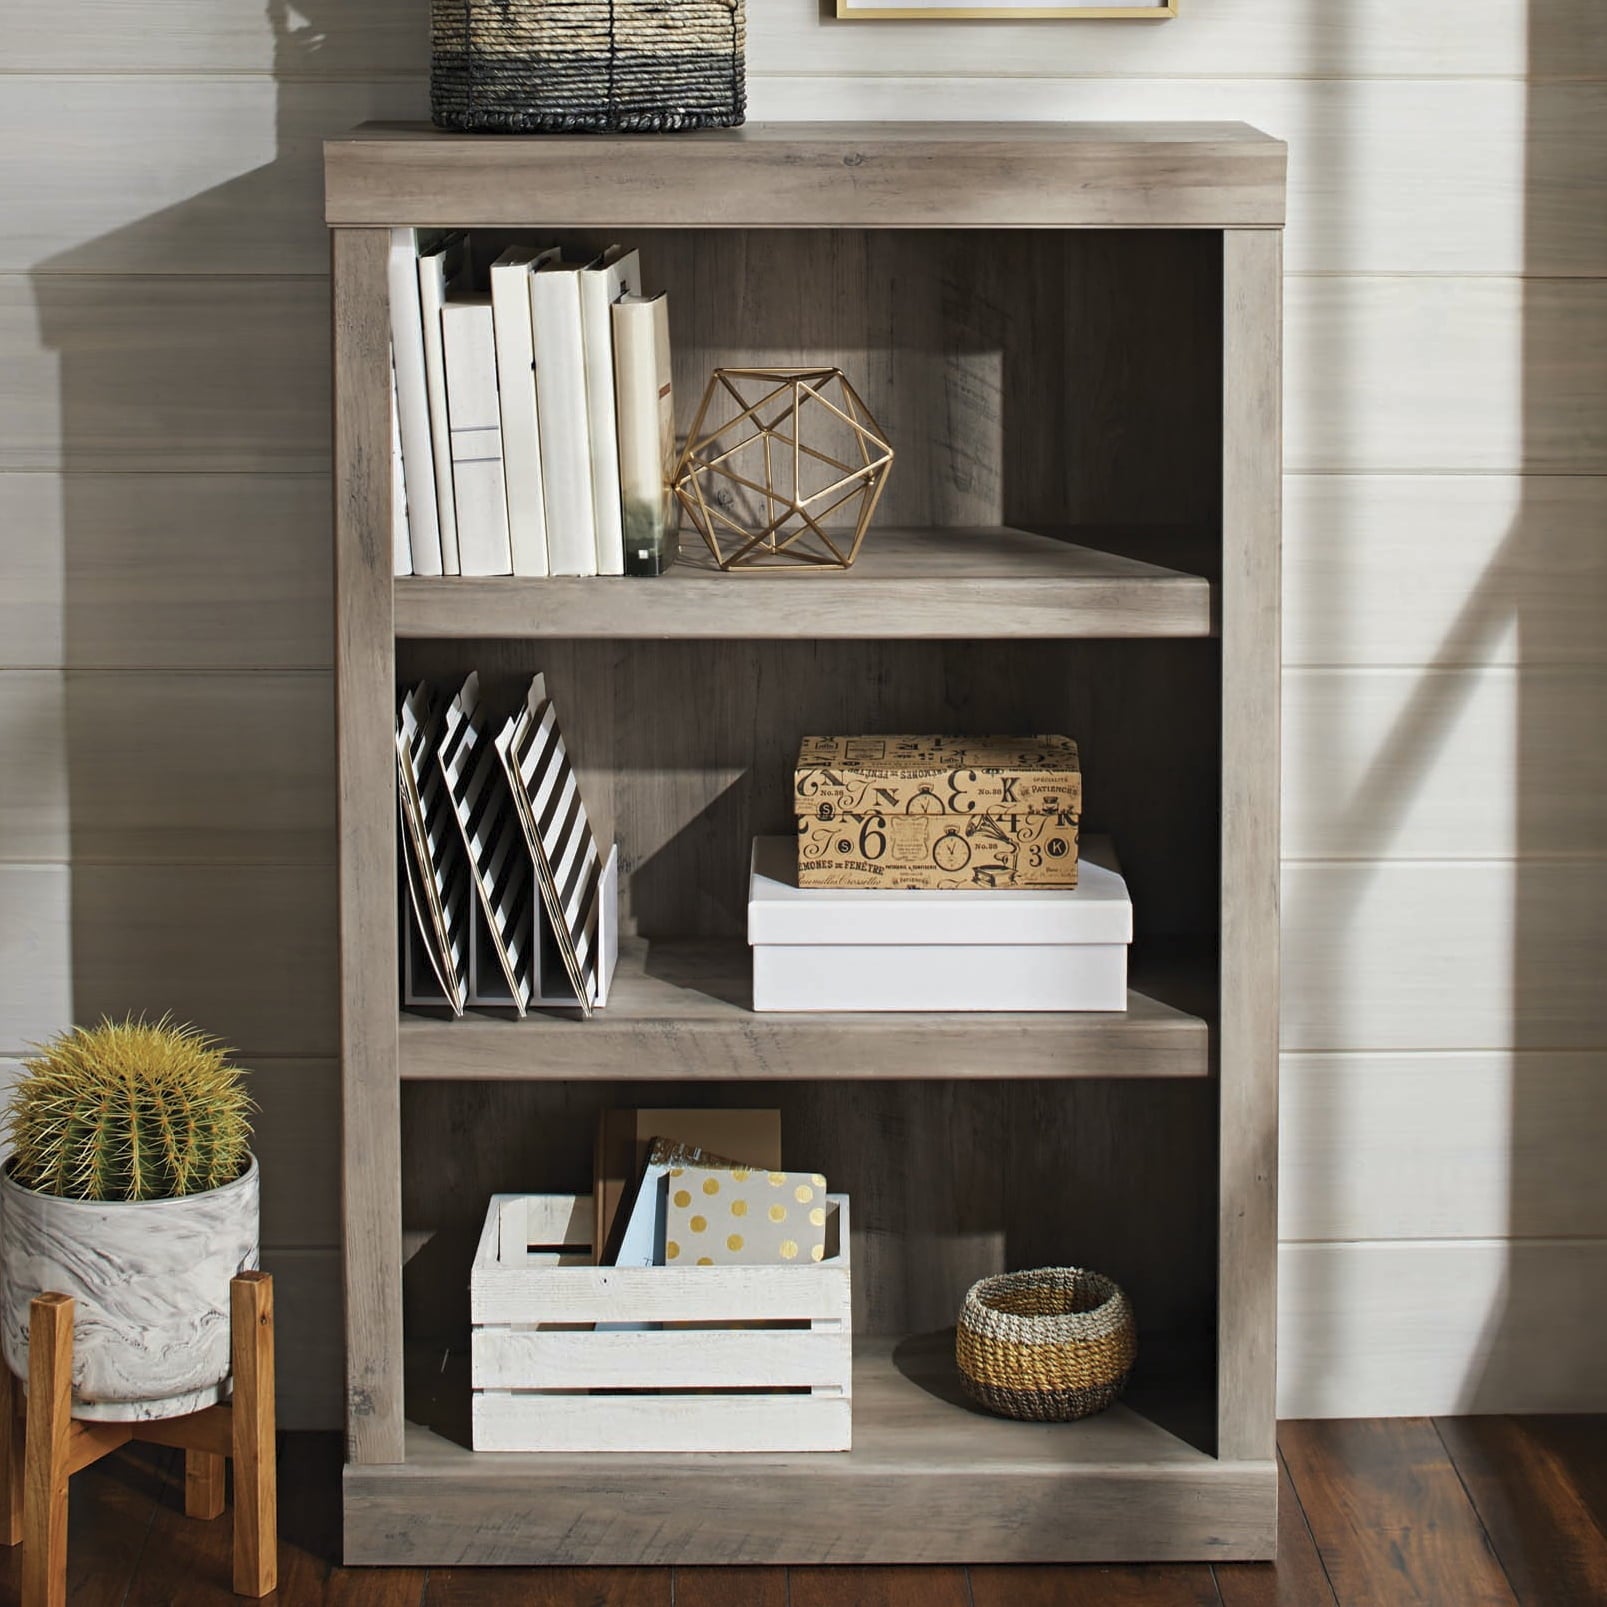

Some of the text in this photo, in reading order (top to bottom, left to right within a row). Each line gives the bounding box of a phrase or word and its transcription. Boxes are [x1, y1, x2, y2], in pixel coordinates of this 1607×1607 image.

[872, 788, 899, 807] N
[1001, 777, 1020, 802] K
[859, 815, 887, 860] 6
[1029, 844, 1043, 867] 3
